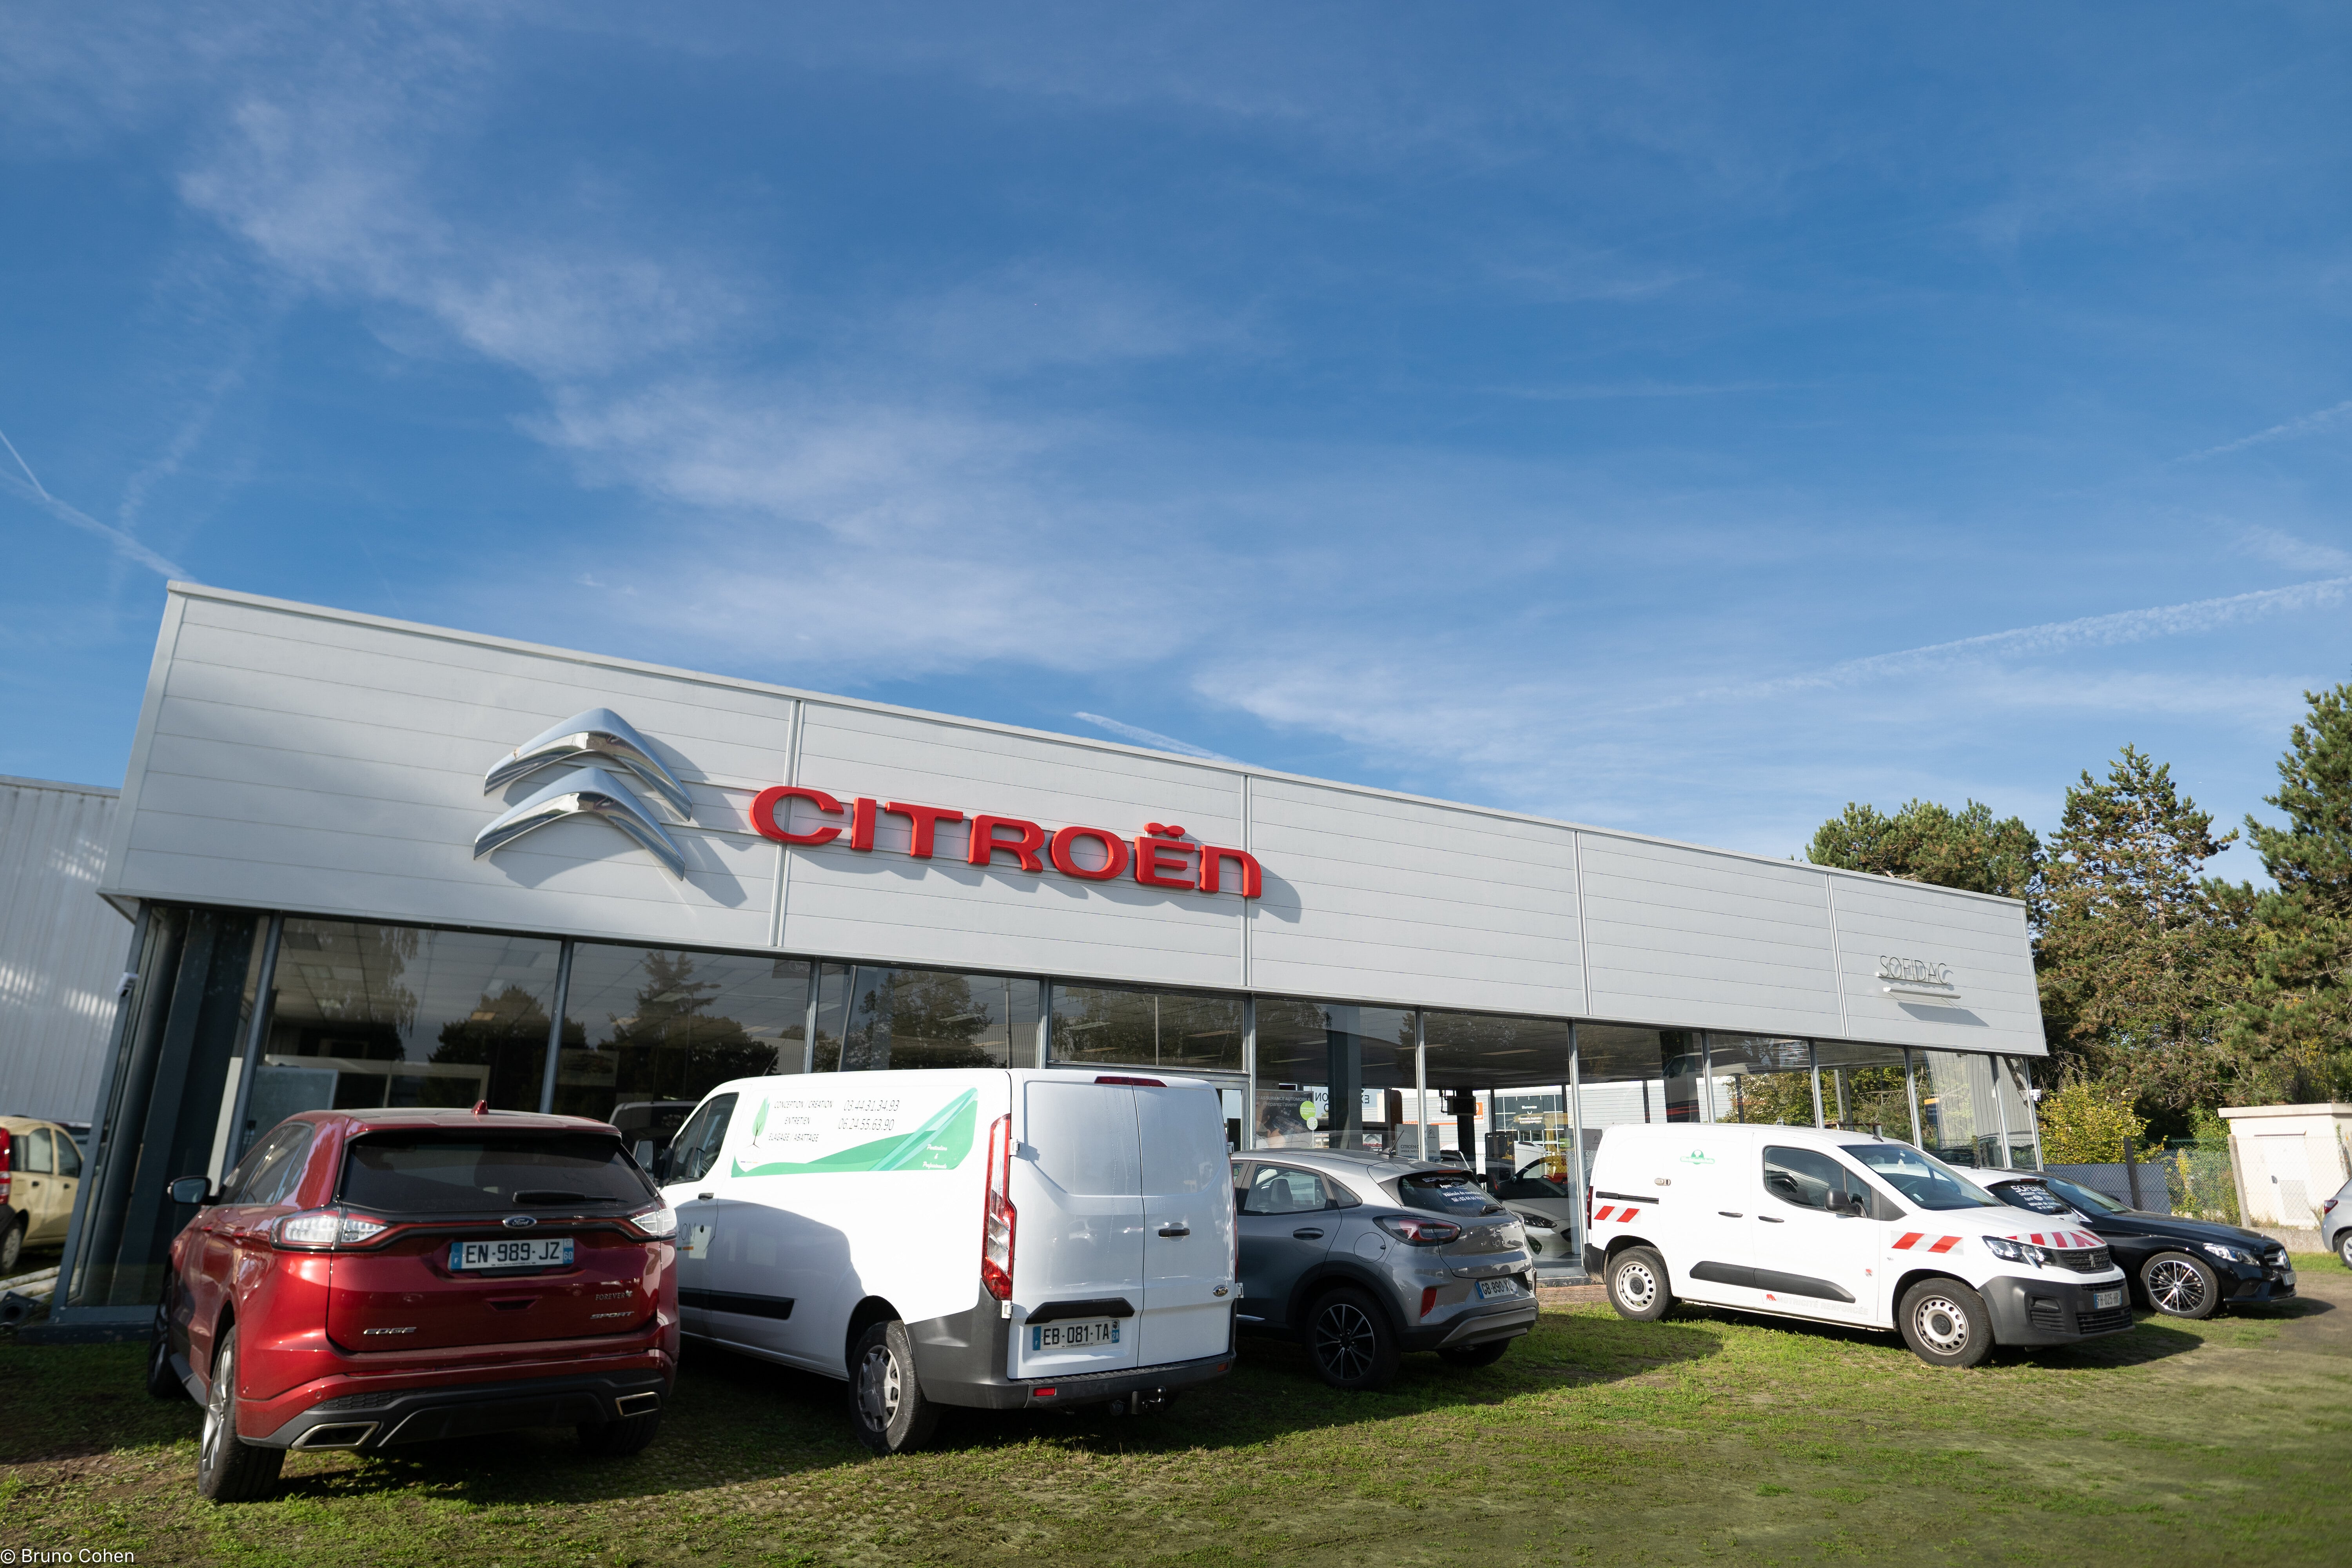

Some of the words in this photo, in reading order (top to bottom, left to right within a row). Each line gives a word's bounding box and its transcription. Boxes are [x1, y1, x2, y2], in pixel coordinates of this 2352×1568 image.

[1880, 955, 1948, 984] SOFIDAC
[844, 1100, 900, 1111] 03.44.31.34.93
[838, 1118, 895, 1131] 06.24.55.63.90
[563, 1251, 573, 1260] 60
[1821, 1302, 1869, 1315] RENFORCÉE
[364, 1327, 417, 1335] EDGE
[1112, 1332, 1119, 1340] 2A
